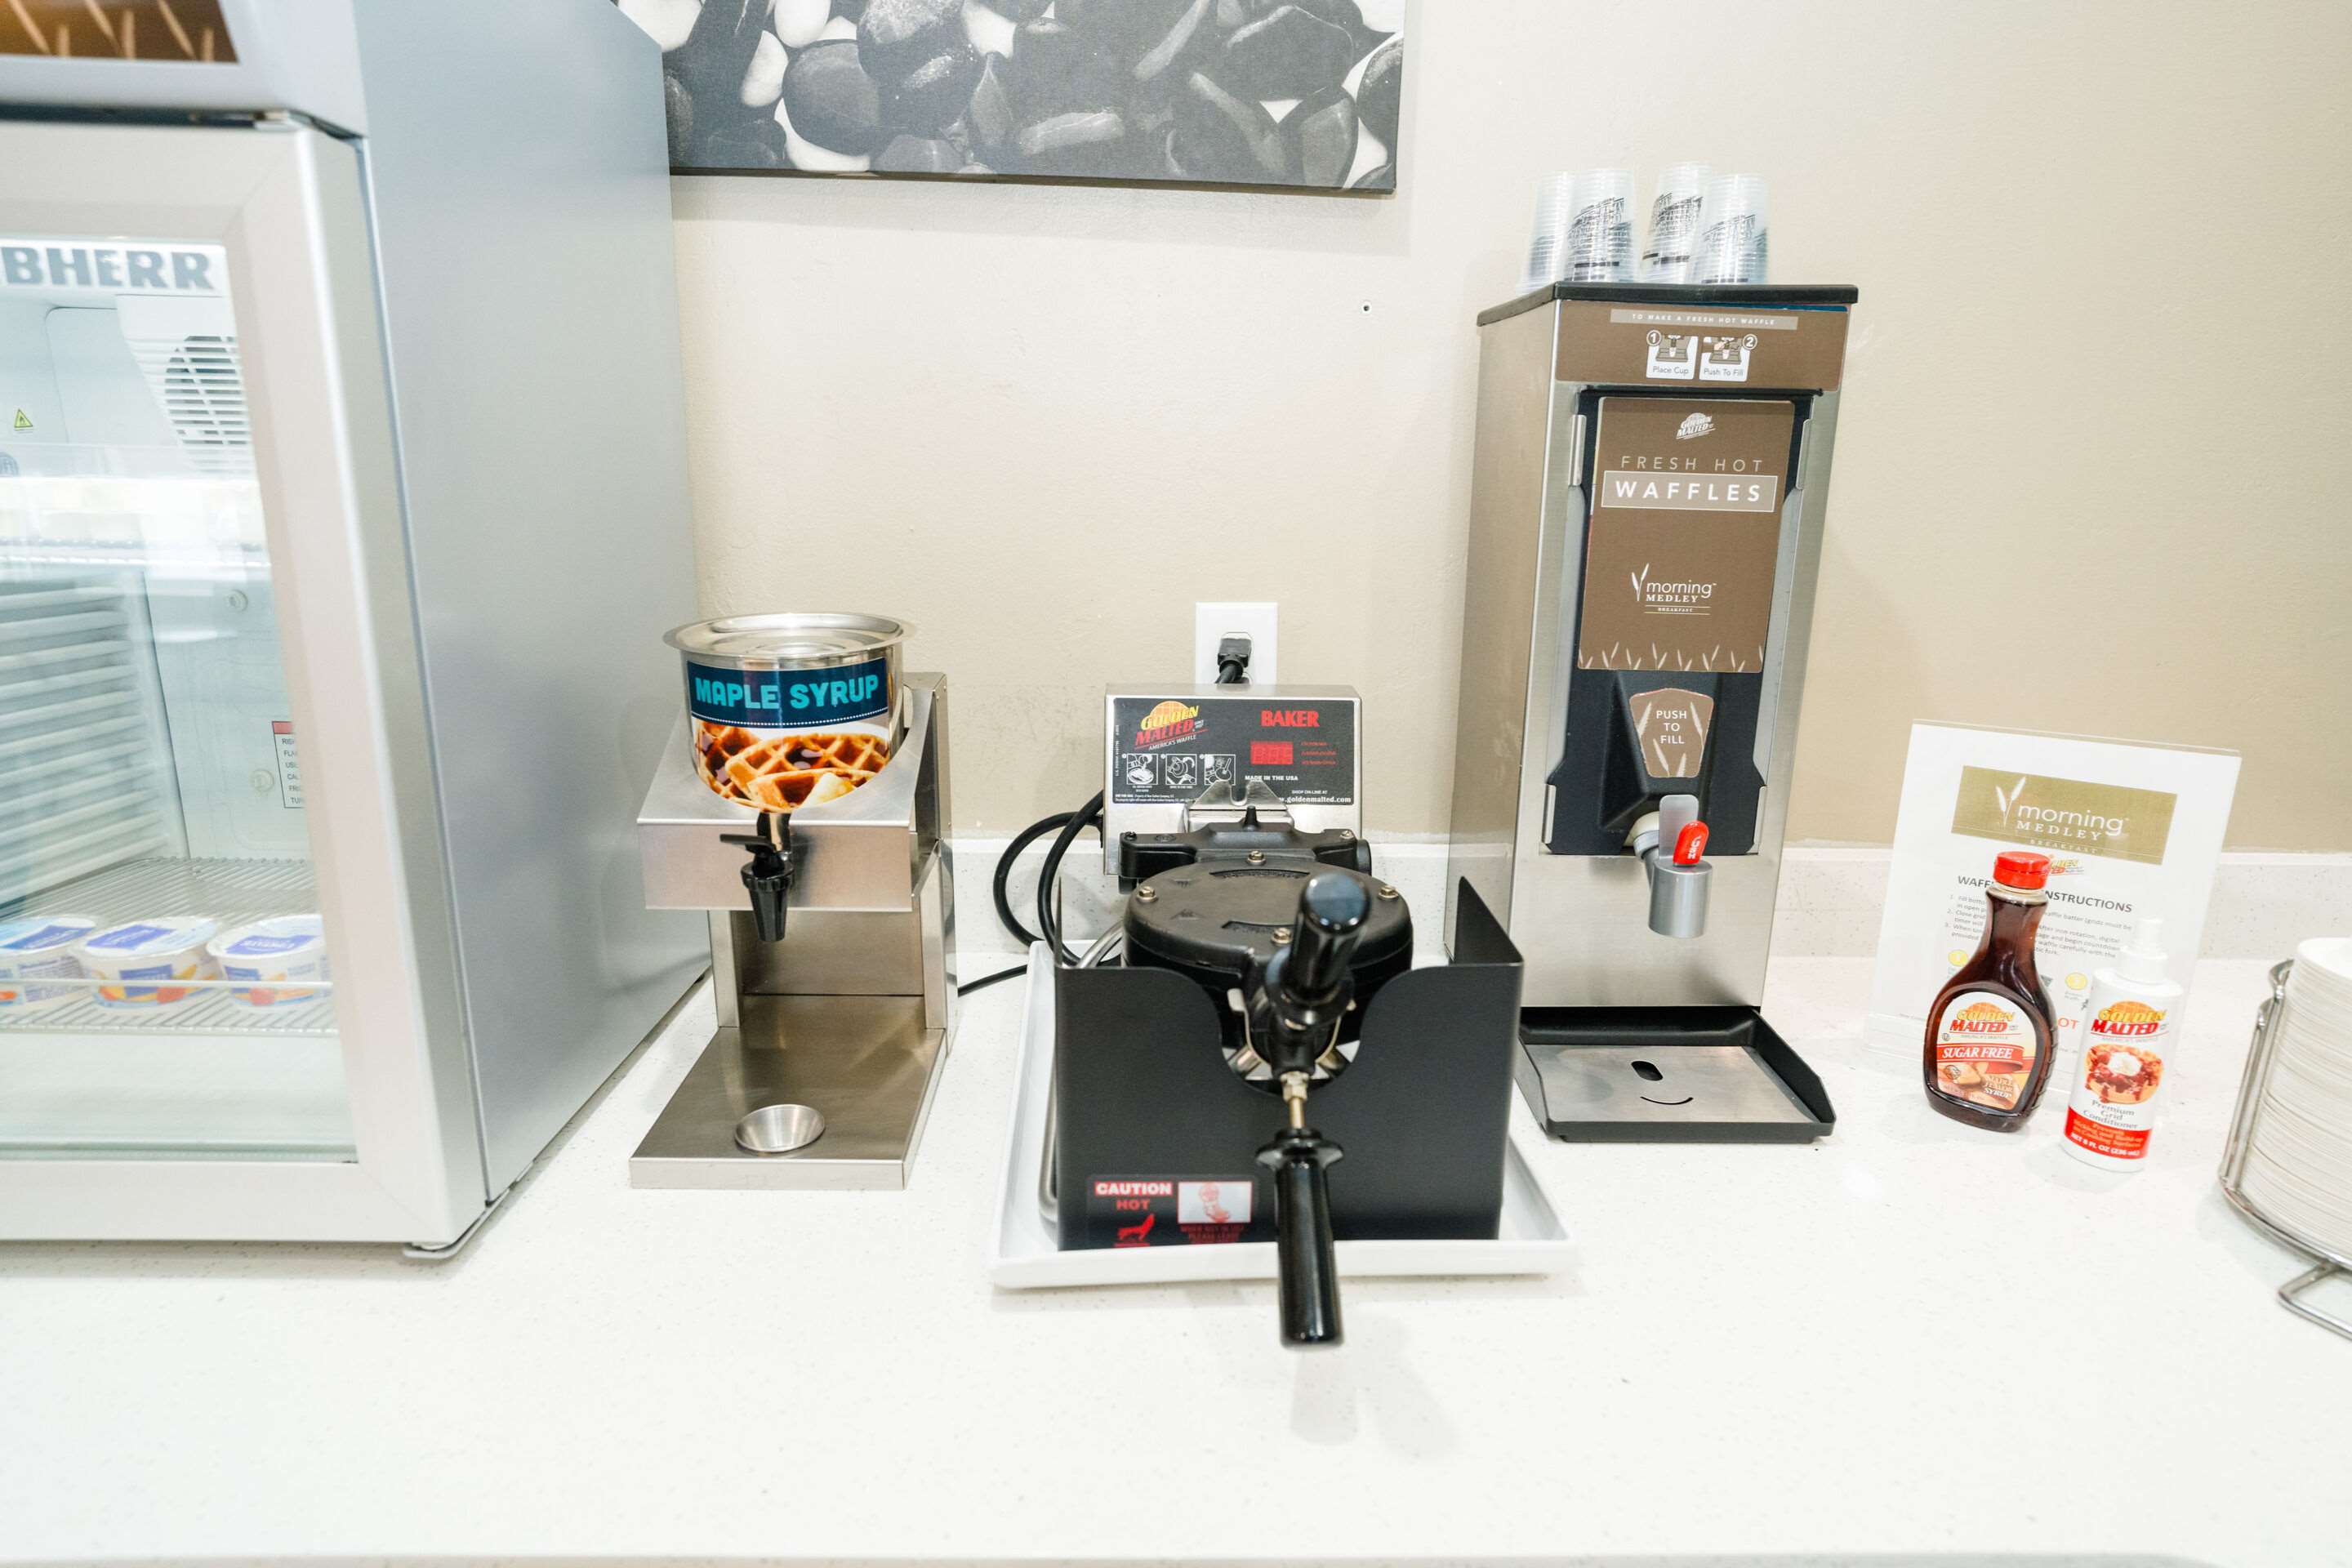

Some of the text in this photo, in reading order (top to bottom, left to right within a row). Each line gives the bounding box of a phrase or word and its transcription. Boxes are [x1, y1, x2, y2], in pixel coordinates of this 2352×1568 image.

[0, 247, 214, 289] BHERR
[1650, 332, 1657, 343] 1
[1745, 336, 1754, 347] 2
[1652, 366, 1689, 376] Place Cup
[1676, 423, 1709, 438] MALTED
[1621, 455, 1763, 473] FRESH HOT
[1615, 480, 1761, 503] WAFFLES
[1646, 579, 1713, 599] morning
[1646, 594, 1699, 603] MEDLEY
[694, 674, 880, 710] MAPLE SYRUP
[1140, 705, 1200, 732] GOLDEN
[1260, 710, 1321, 728] BAKER
[1655, 710, 1687, 720] PUSH
[1135, 718, 1195, 746] MALTED
[1664, 723, 1681, 732] TO
[1176, 734, 1197, 743] WAFFLE
[1659, 734, 1686, 745] FILL
[2018, 804, 2124, 836] morning
[2016, 821, 2102, 841] MEDLEY
[2030, 839, 2099, 853] BREAKFAST
[1958, 876, 2132, 912] WAFF NSTRUCTIONS
[2065, 936, 2083, 946] begin
[1957, 1009, 2015, 1022] GOLDEN
[2098, 1008, 2167, 1022] GOLDEN
[1949, 1019, 2008, 1032] MALTED
[2057, 1018, 2080, 1030] OT
[2091, 1018, 2159, 1035] MALTED
[1942, 1047, 2015, 1059] SUGAR FREE
[1984, 1087, 2012, 1098] SYRUP
[2091, 1099, 2135, 1116] Premium
[2083, 1110, 2138, 1129] Conditioner
[2100, 1110, 2123, 1120] Grid
[2070, 1132, 2082, 1143] NET
[2088, 1141, 2098, 1149] FL
[2098, 1144, 2111, 1152] OZ
[1096, 1183, 1173, 1196] CAUTION
[1116, 1199, 1150, 1210] HOT
